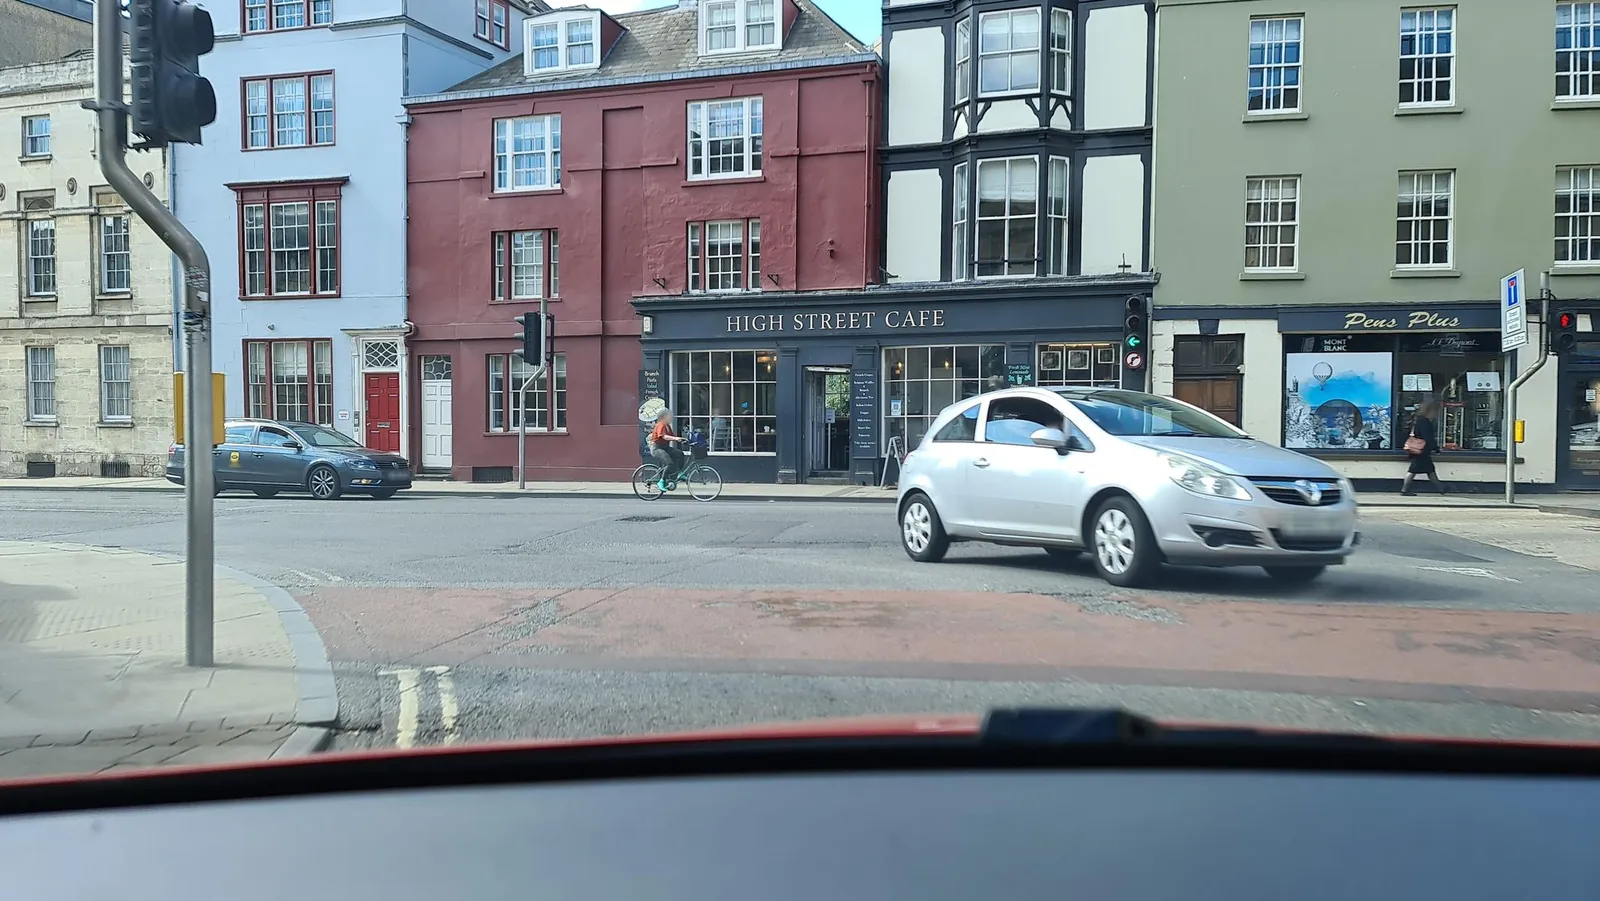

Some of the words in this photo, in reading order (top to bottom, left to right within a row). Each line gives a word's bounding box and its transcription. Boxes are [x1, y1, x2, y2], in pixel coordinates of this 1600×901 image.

[726, 315, 783, 332] HIGH
[793, 312, 875, 331] STREET
[884, 309, 945, 329] CAFE
[1344, 312, 1398, 329] Pens
[1408, 311, 1460, 328] Plus
